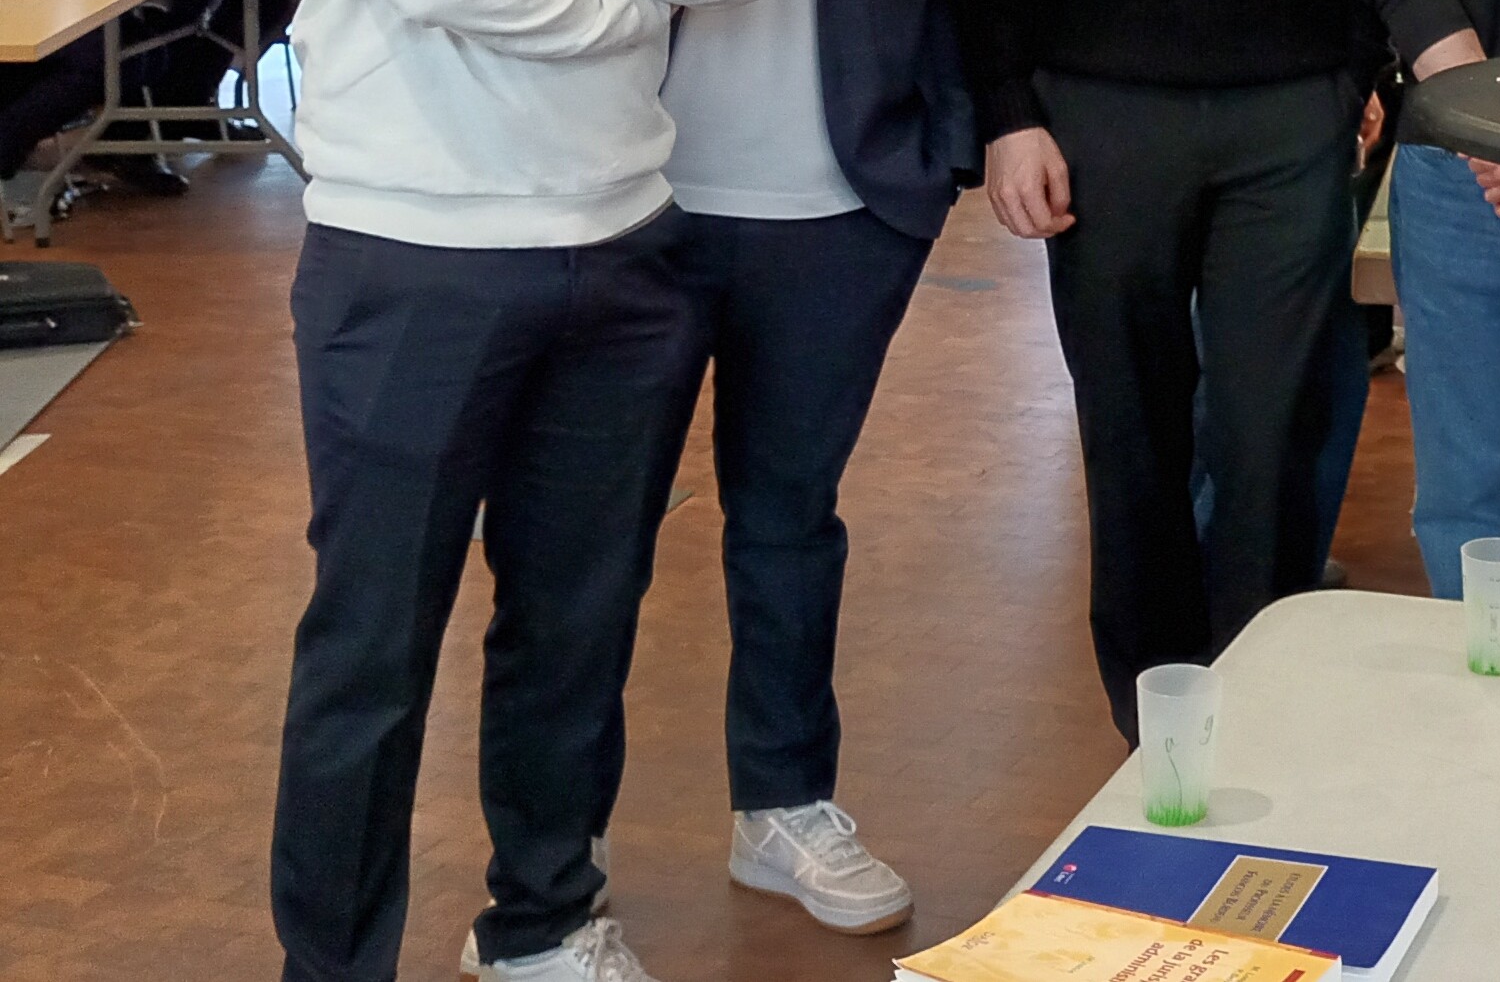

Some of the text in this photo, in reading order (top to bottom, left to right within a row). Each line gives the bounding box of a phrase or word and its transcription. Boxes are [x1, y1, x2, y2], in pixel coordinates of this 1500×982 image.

[1139, 938, 1204, 982] de la juris
[1202, 949, 1230, 966] Les
[1180, 964, 1208, 982] gra
